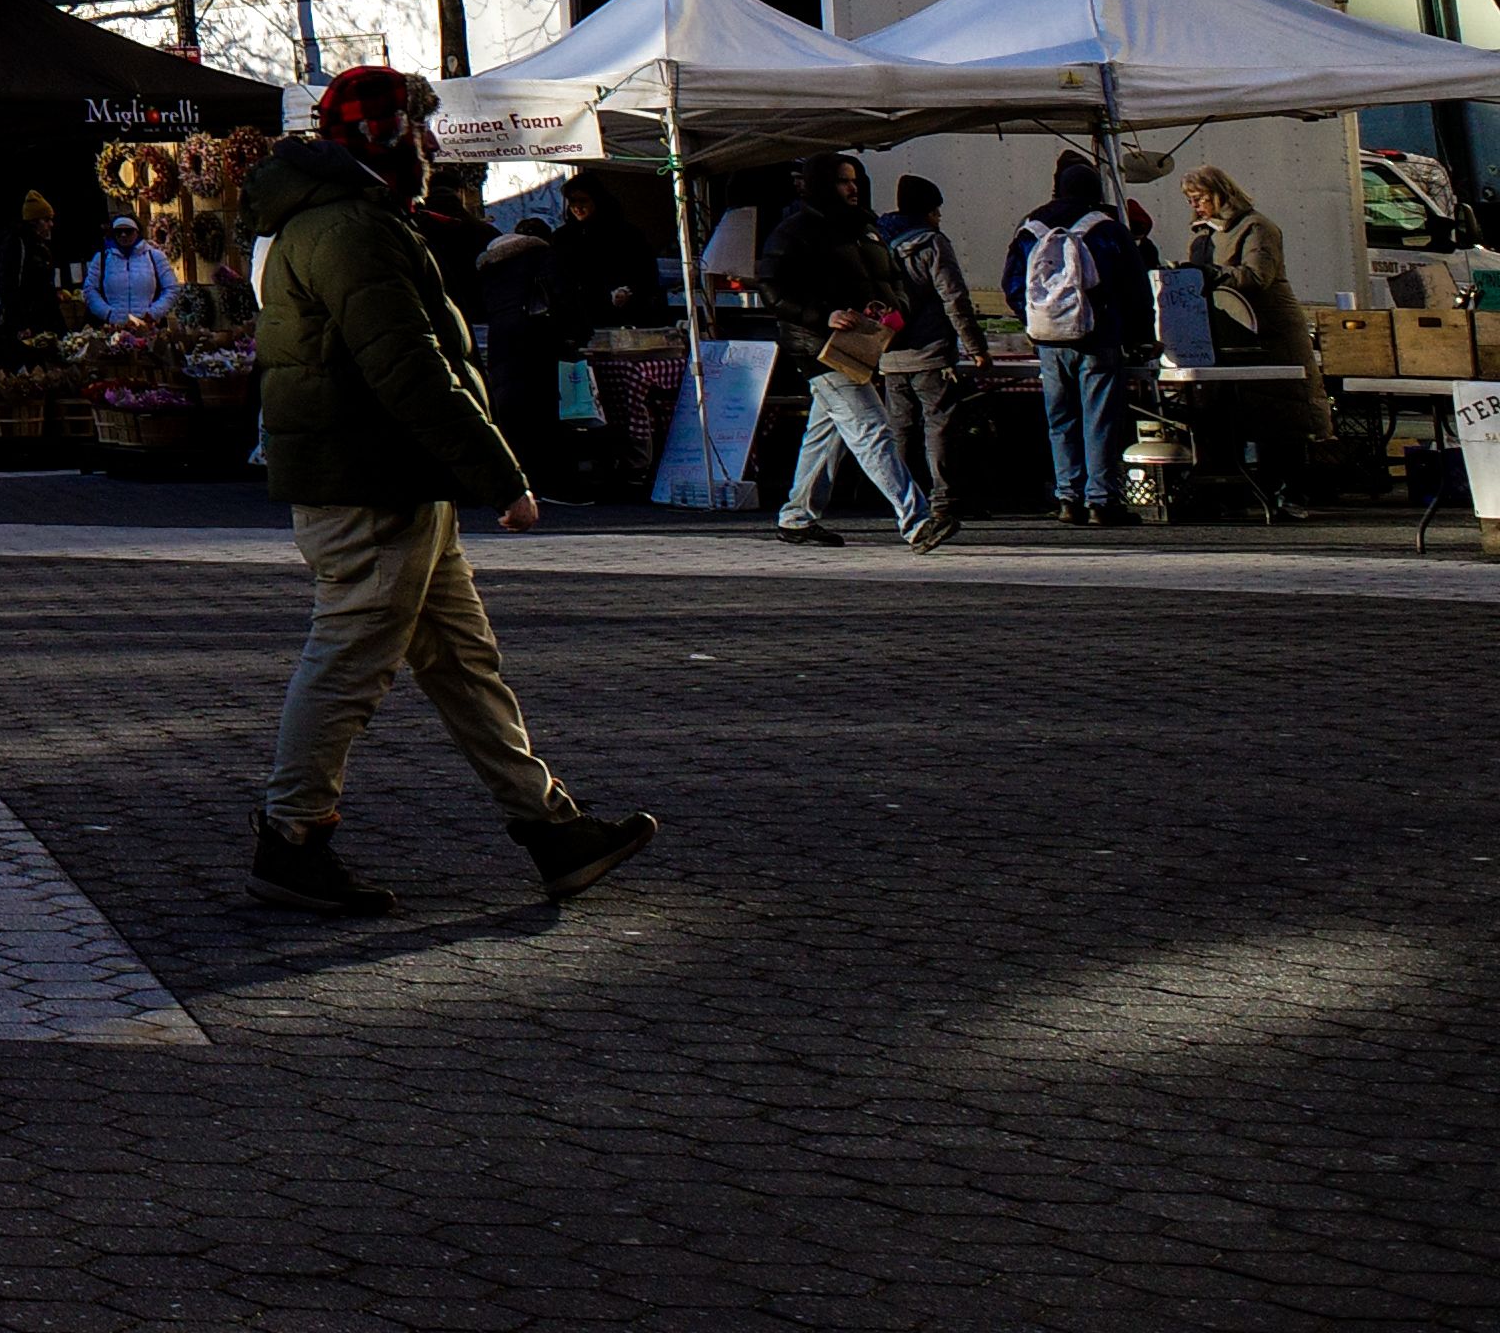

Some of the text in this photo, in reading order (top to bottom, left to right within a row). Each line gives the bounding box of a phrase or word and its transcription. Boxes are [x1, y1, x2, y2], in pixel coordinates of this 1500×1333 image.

[437, 114, 563, 135] Corner Farm
[454, 144, 526, 158] Farmstead
[528, 144, 583, 156] Cheeses
